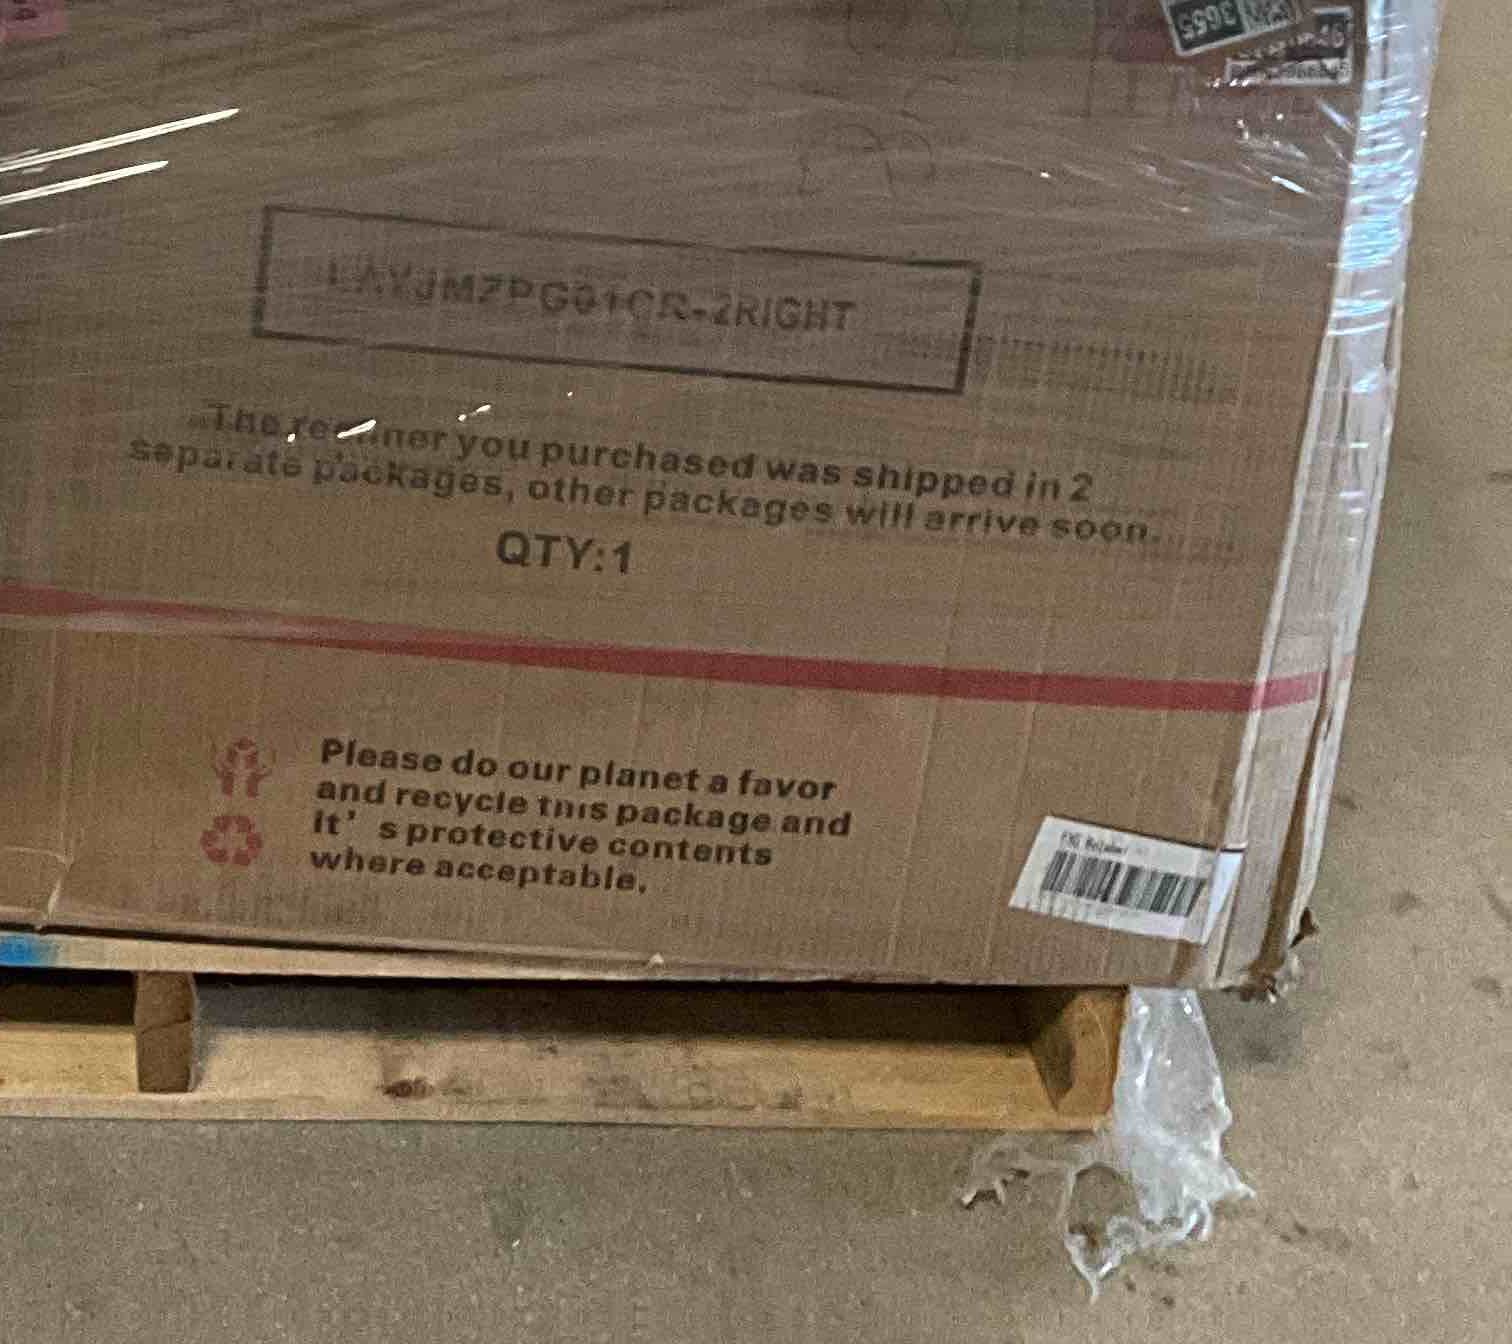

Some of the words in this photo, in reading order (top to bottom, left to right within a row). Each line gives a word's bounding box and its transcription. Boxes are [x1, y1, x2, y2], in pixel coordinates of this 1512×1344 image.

[209, 403, 284, 437] The
[456, 431, 530, 463] you
[540, 438, 754, 481] purchased
[765, 460, 841, 486] was
[854, 462, 1015, 500] shipped
[1025, 470, 1060, 501] in
[1069, 472, 1094, 504] 2
[130, 438, 303, 479] separate
[313, 456, 515, 505] packages,
[528, 478, 634, 510] other
[645, 485, 834, 526] packages
[847, 501, 915, 531] will
[924, 510, 1039, 538] arrive
[1051, 517, 1159, 545] soon.
[496, 530, 632, 575] QTY:1
[320, 737, 442, 775] Please
[451, 748, 498, 779] do
[508, 760, 572, 783] our
[579, 760, 700, 794] planet
[707, 773, 728, 794] a
[739, 767, 836, 803] favor
[316, 777, 386, 806] and
[395, 781, 528, 820] recycle
[536, 794, 609, 821] this
[616, 799, 772, 836] package
[781, 810, 851, 838] and
[309, 846, 426, 877] where
[434, 857, 647, 895] acceptable.
[406, 820, 598, 856] protective
[607, 834, 774, 867] contents
